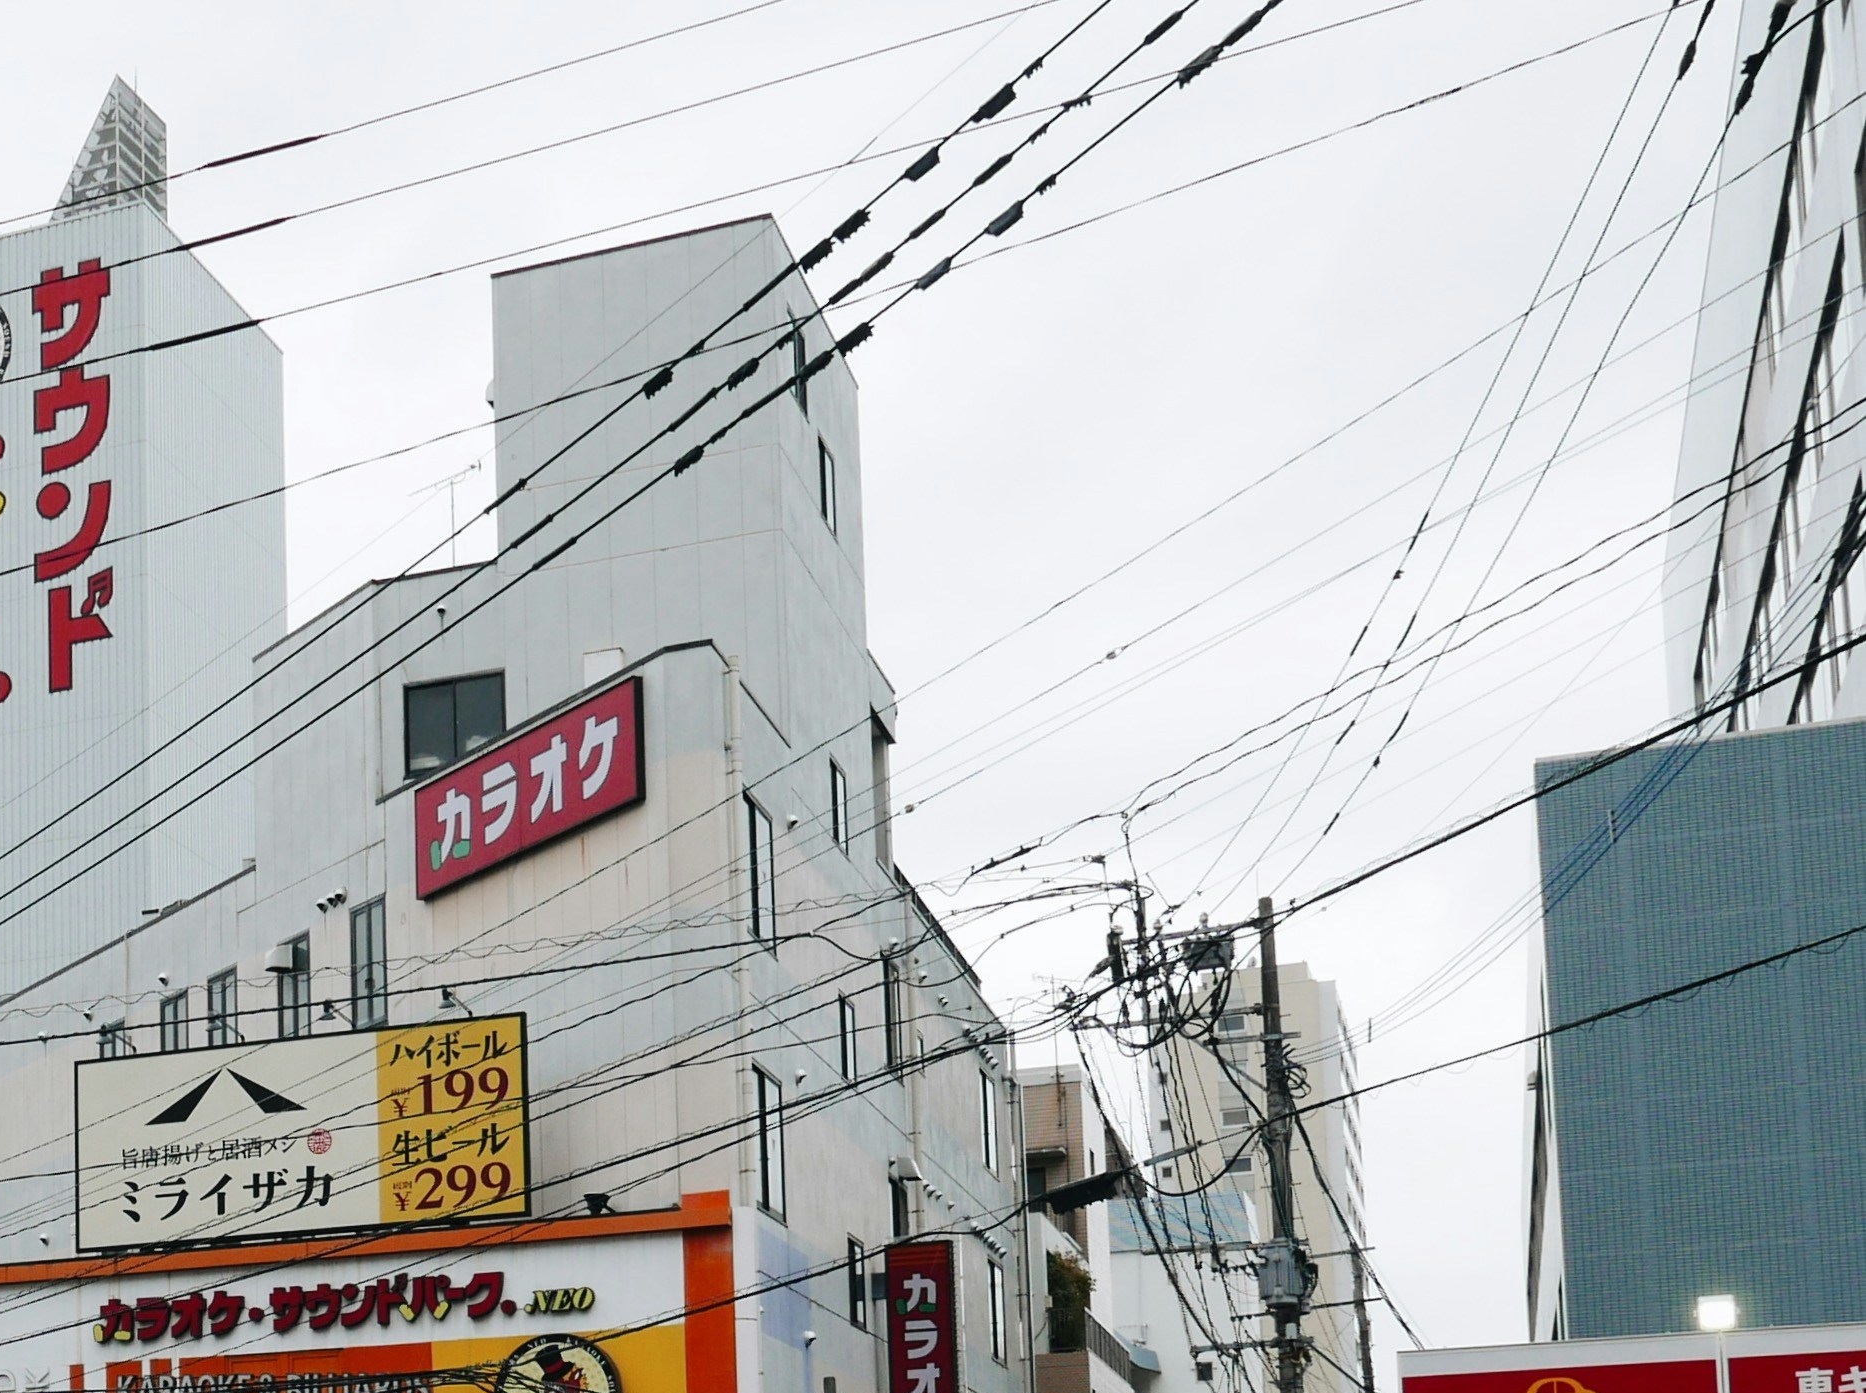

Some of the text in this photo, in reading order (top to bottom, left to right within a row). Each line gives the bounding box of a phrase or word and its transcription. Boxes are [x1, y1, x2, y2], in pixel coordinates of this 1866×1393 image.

[33, 257, 113, 693] サウンド
[430, 716, 619, 870] カラオケ
[390, 1030, 508, 1069] ハイボール
[392, 1122, 510, 1167] 生ビール
[122, 1166, 334, 1223] ミライザカ
